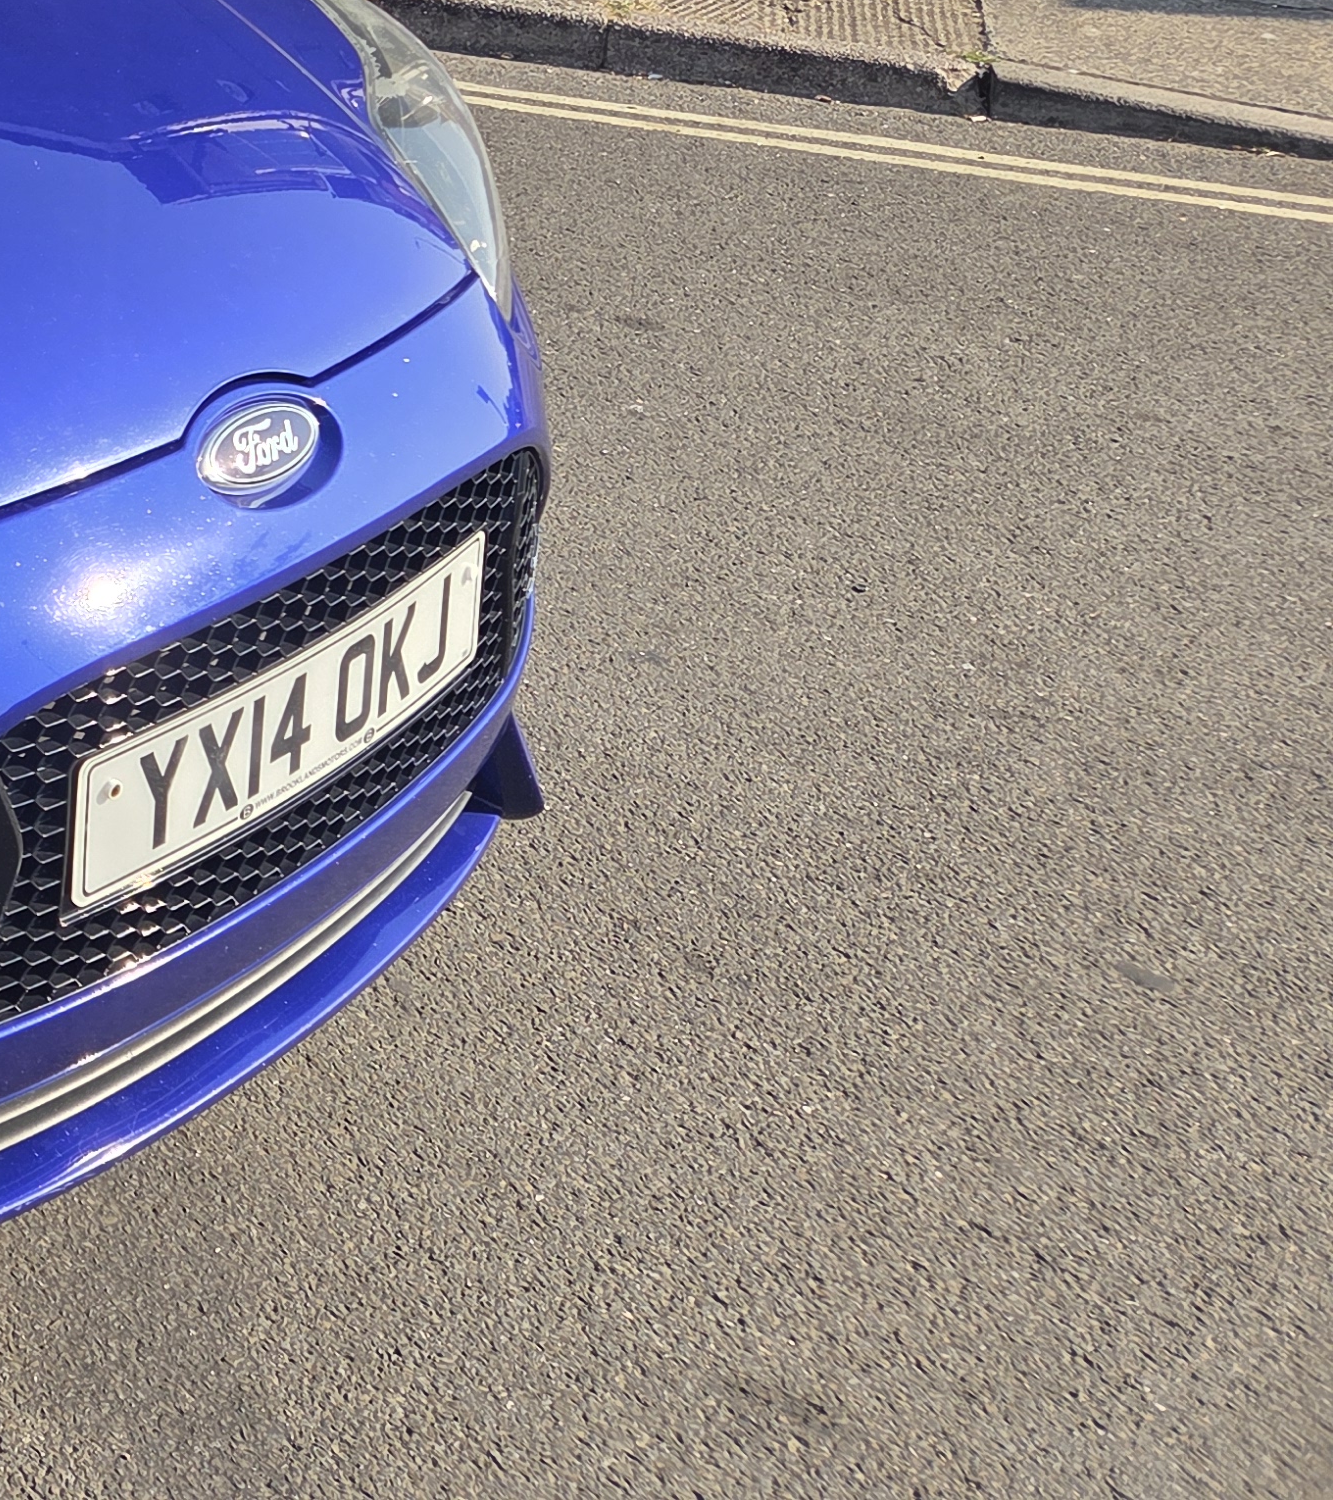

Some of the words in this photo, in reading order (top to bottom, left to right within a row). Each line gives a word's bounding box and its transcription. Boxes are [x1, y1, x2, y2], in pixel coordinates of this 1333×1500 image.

[232, 418, 299, 474] Ford
[140, 673, 312, 850] YX14
[335, 573, 453, 744] OKJ
